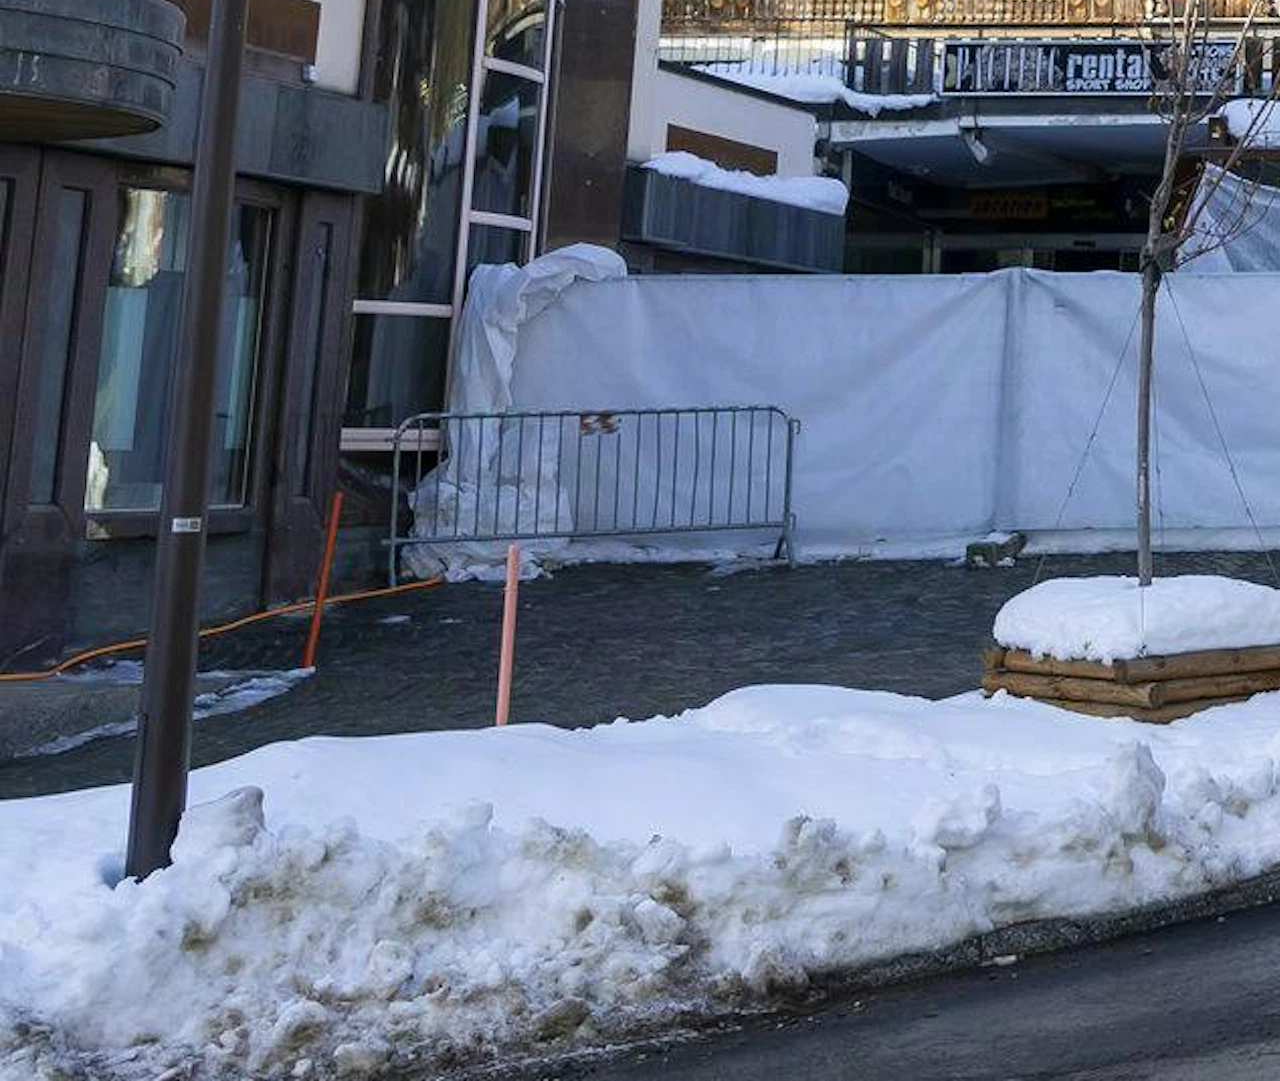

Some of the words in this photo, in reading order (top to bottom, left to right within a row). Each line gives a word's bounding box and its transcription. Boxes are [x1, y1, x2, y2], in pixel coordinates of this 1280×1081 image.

[1066, 48, 1151, 79] rental
[1066, 78, 1111, 92] SPORT
[1114, 78, 1151, 92] SHOP
